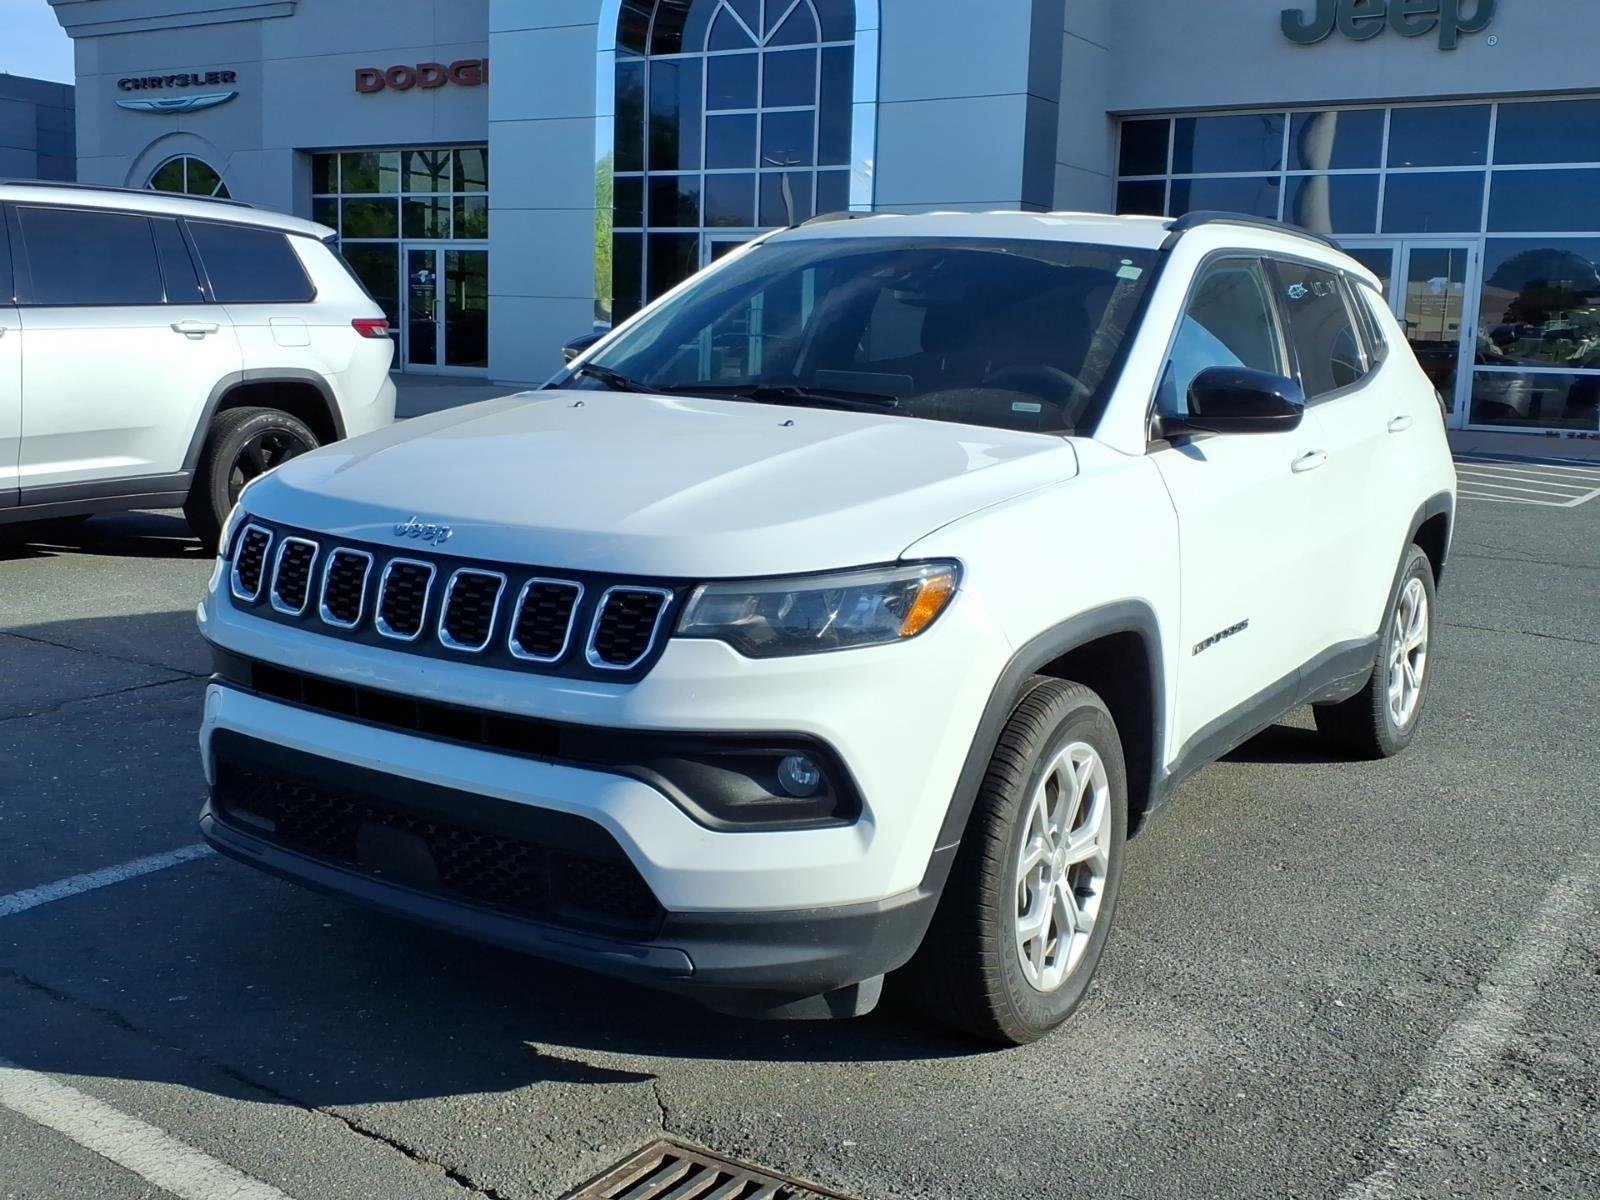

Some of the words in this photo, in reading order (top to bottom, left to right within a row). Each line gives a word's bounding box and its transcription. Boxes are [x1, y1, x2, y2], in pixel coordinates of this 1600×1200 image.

[1281, 0, 1495, 50] Jeep
[117, 70, 237, 91] CHRYSLER
[355, 58, 489, 93] DODG
[393, 516, 453, 547] Jeep
